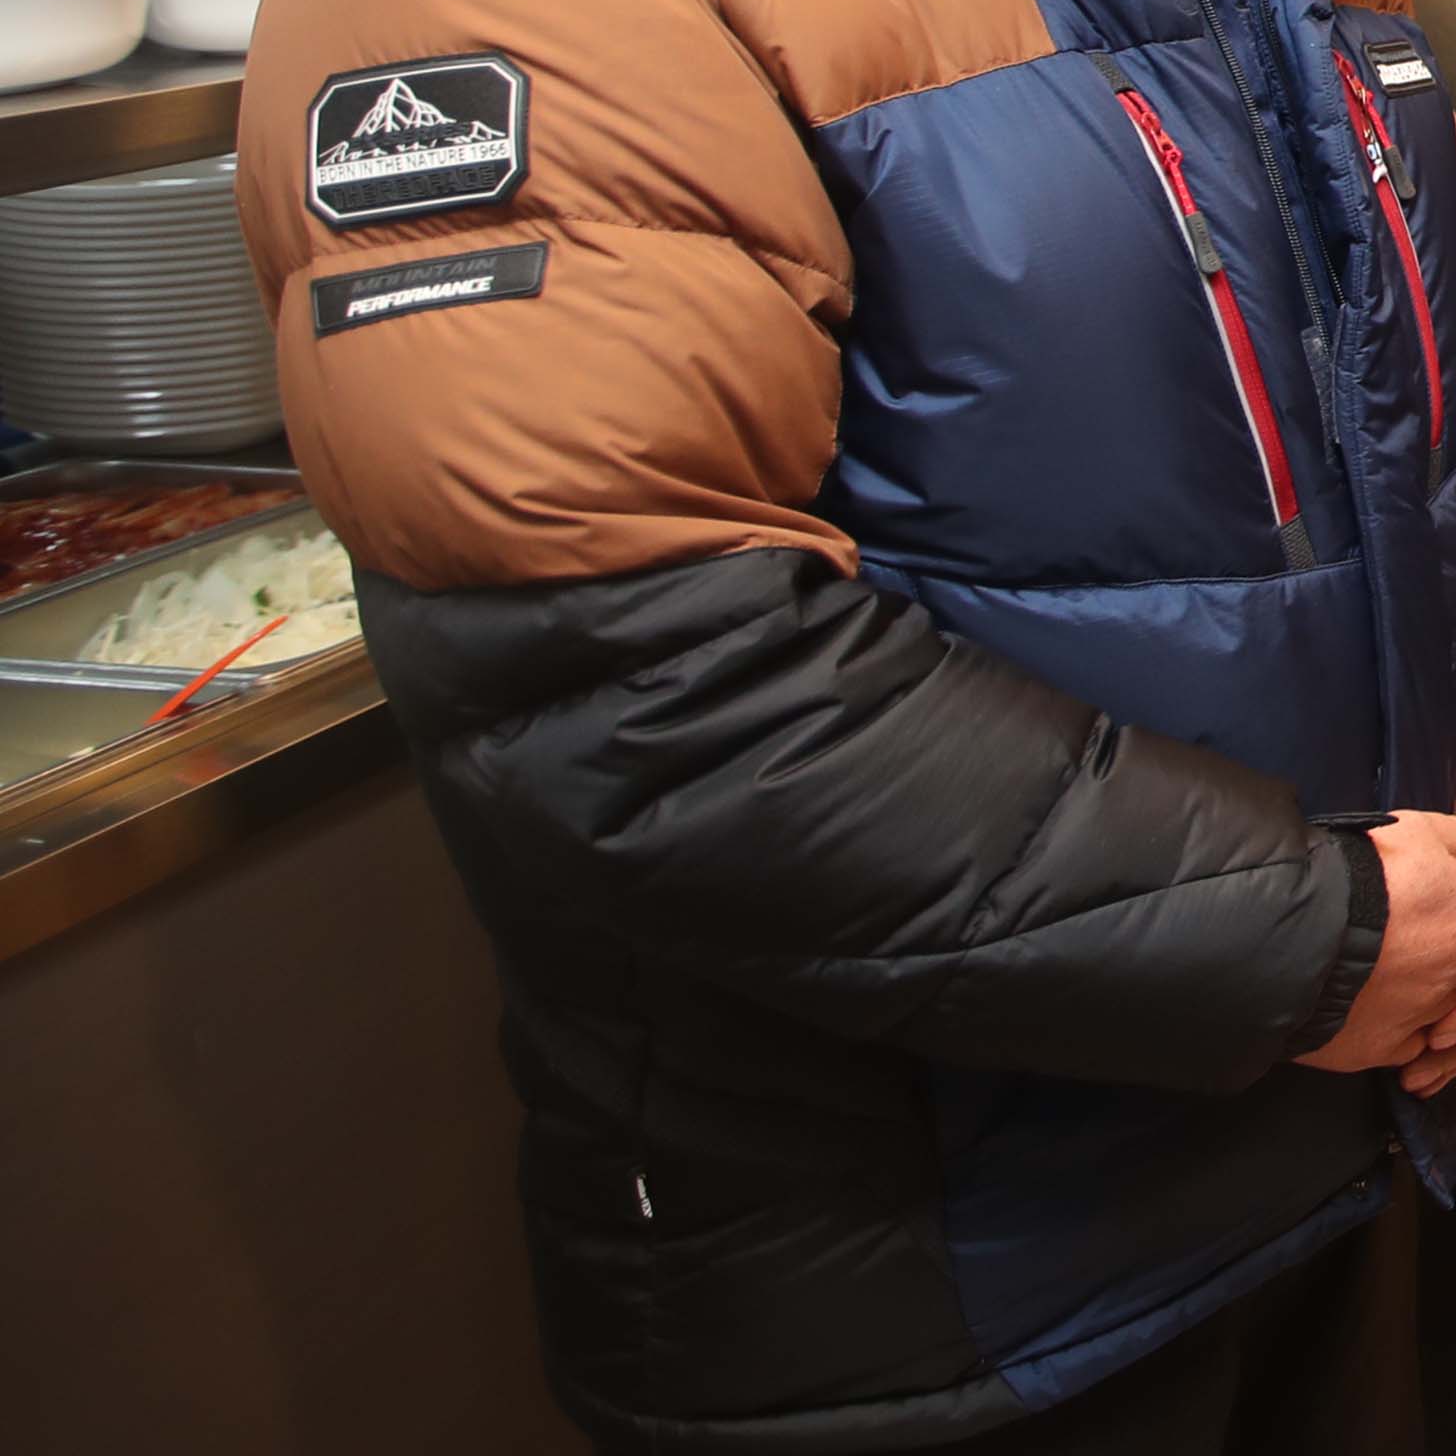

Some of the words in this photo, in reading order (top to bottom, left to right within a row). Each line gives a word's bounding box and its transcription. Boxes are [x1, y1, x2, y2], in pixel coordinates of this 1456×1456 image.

[319, 164, 356, 184] BORN
[358, 162, 373, 177] IN
[376, 157, 402, 173] THE
[406, 148, 466, 170] NATURE
[351, 256, 497, 293] MOUNTAIN
[346, 275, 495, 318] PERFORMANCE
